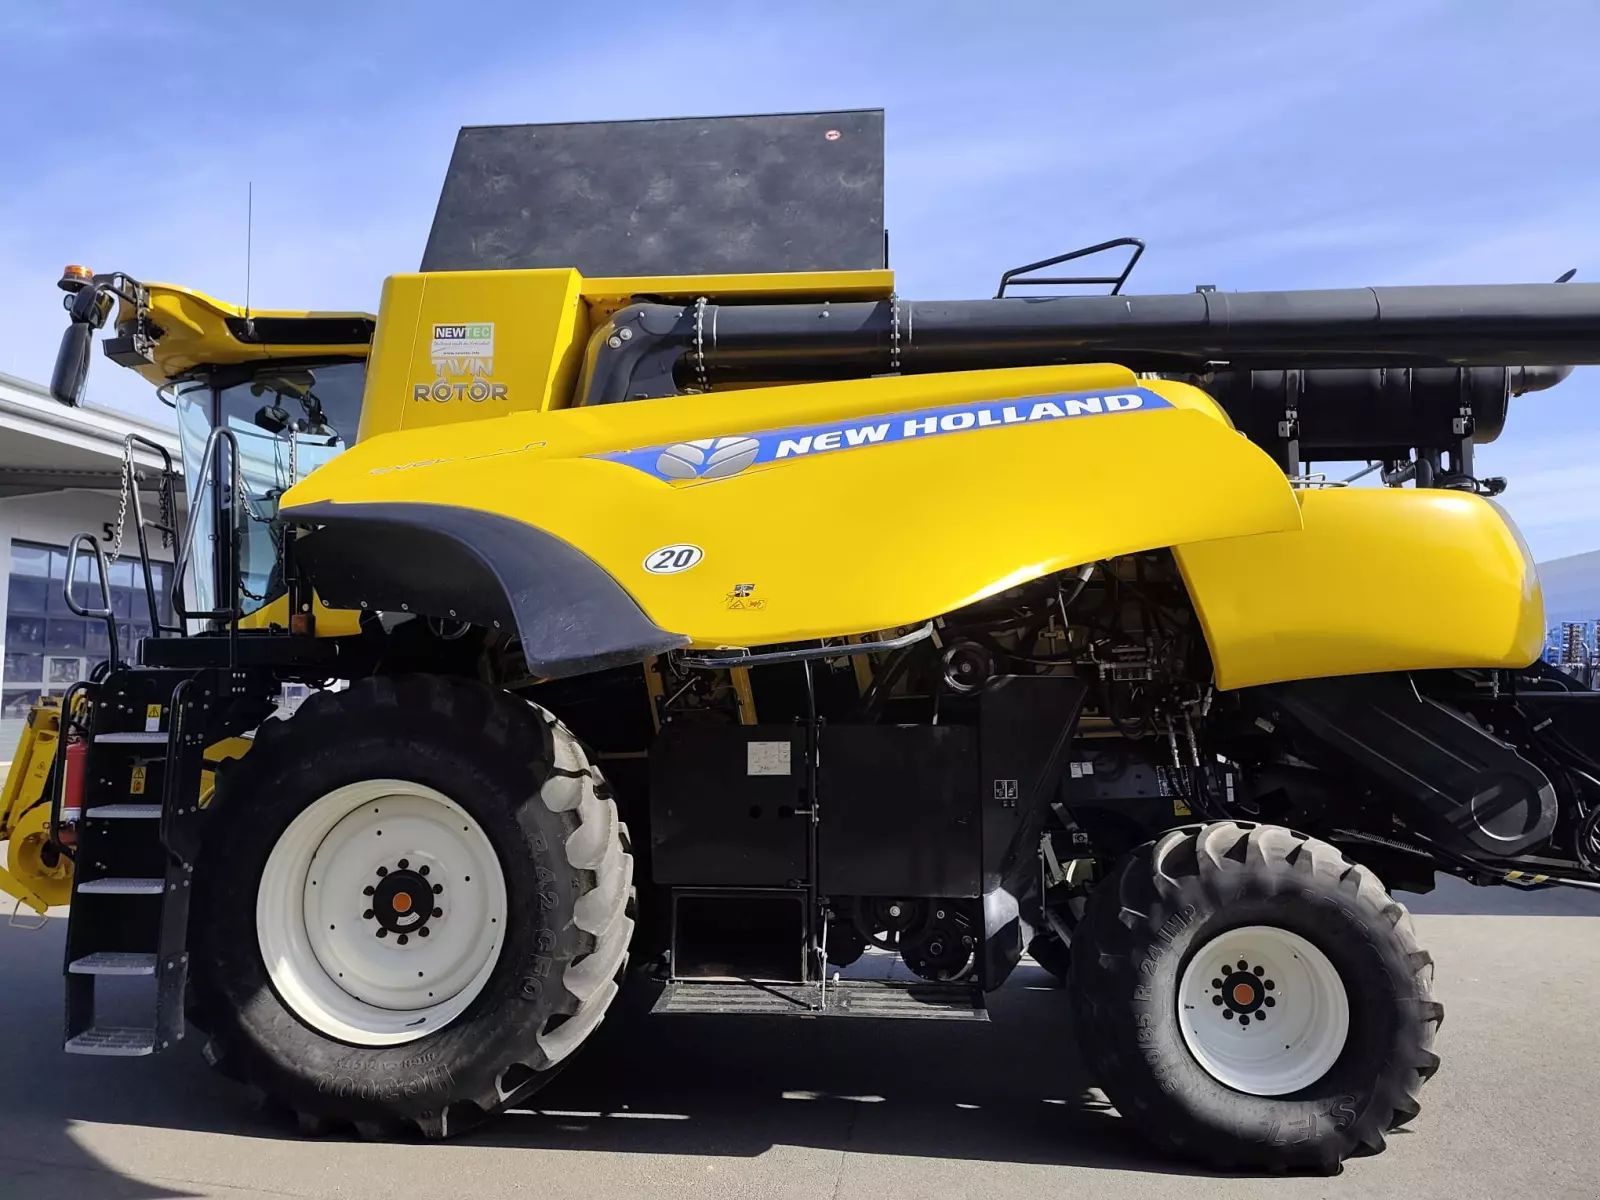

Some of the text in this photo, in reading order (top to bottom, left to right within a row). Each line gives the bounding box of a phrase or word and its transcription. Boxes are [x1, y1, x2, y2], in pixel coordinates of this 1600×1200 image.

[413, 380, 508, 402] ROTOR
[775, 394, 1143, 458] NEW HOLLAND
[103, 522, 114, 542] 5
[653, 549, 694, 569] 20
